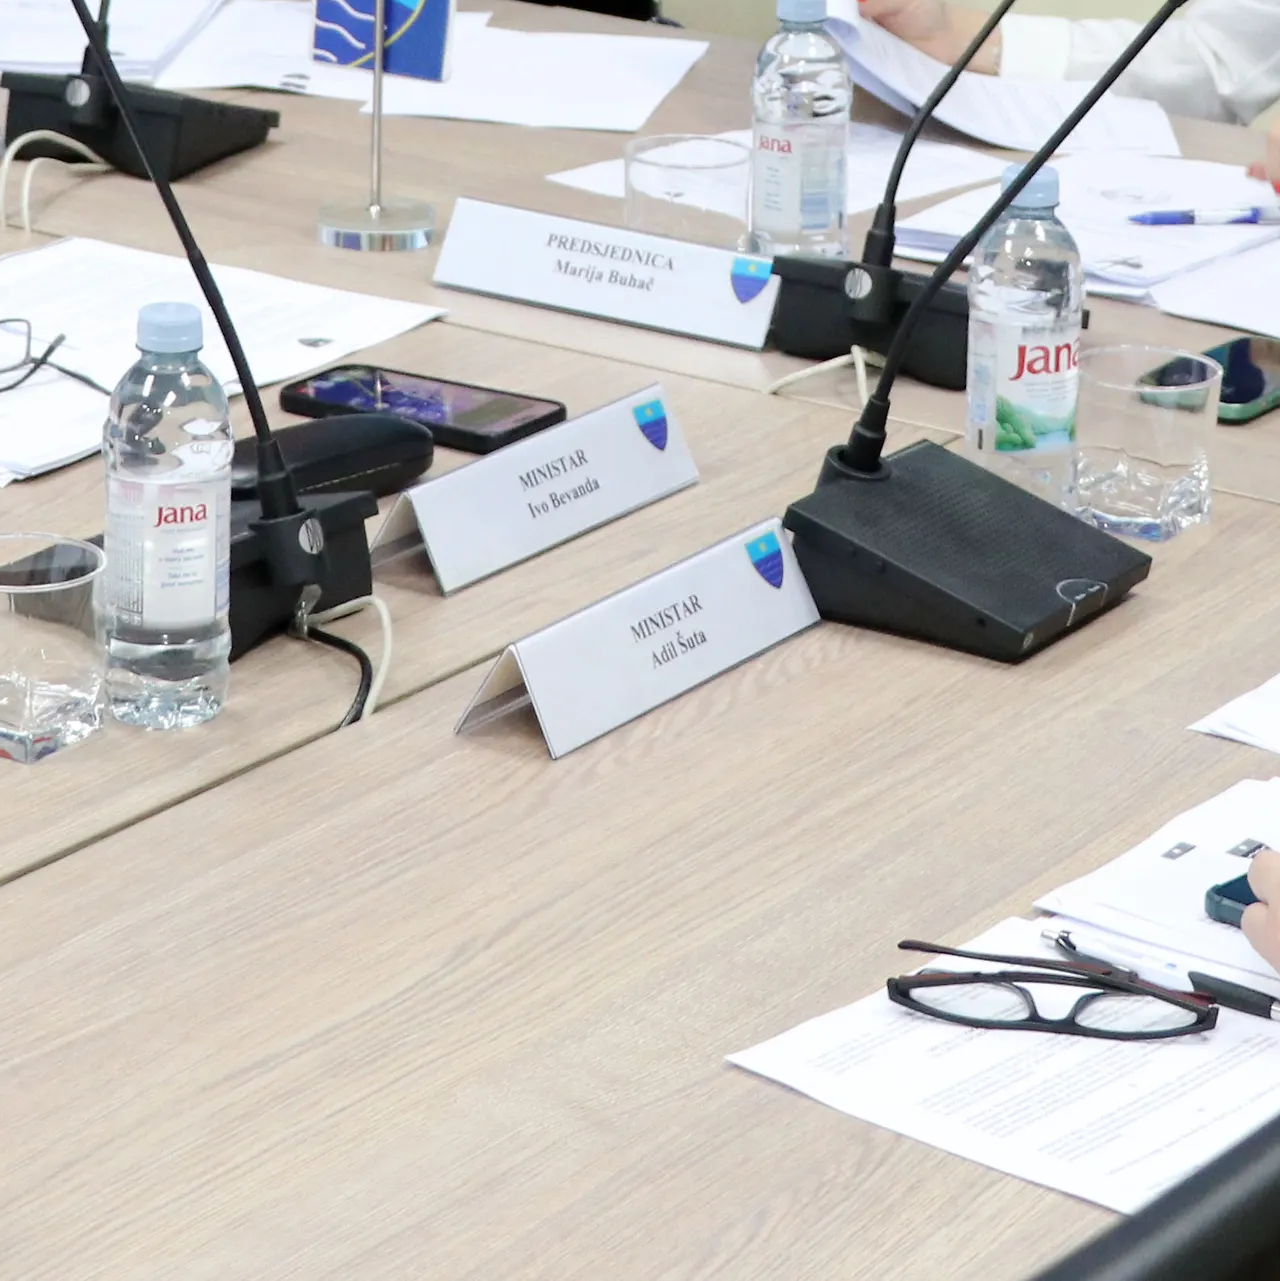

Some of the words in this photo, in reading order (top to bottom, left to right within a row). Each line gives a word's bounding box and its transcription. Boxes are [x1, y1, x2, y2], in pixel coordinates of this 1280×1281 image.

[545, 231, 675, 271] PREDSJEDNICA
[553, 258, 604, 284] Marija
[607, 268, 655, 293] Buhač
[518, 448, 589, 493] MINISTAR
[152, 502, 209, 528] Jana
[527, 501, 550, 519] Ivo
[548, 475, 601, 510] Bevanda
[629, 593, 704, 644] MINISTAR
[651, 639, 678, 670] Adil
[675, 629, 708, 656] Šuta
